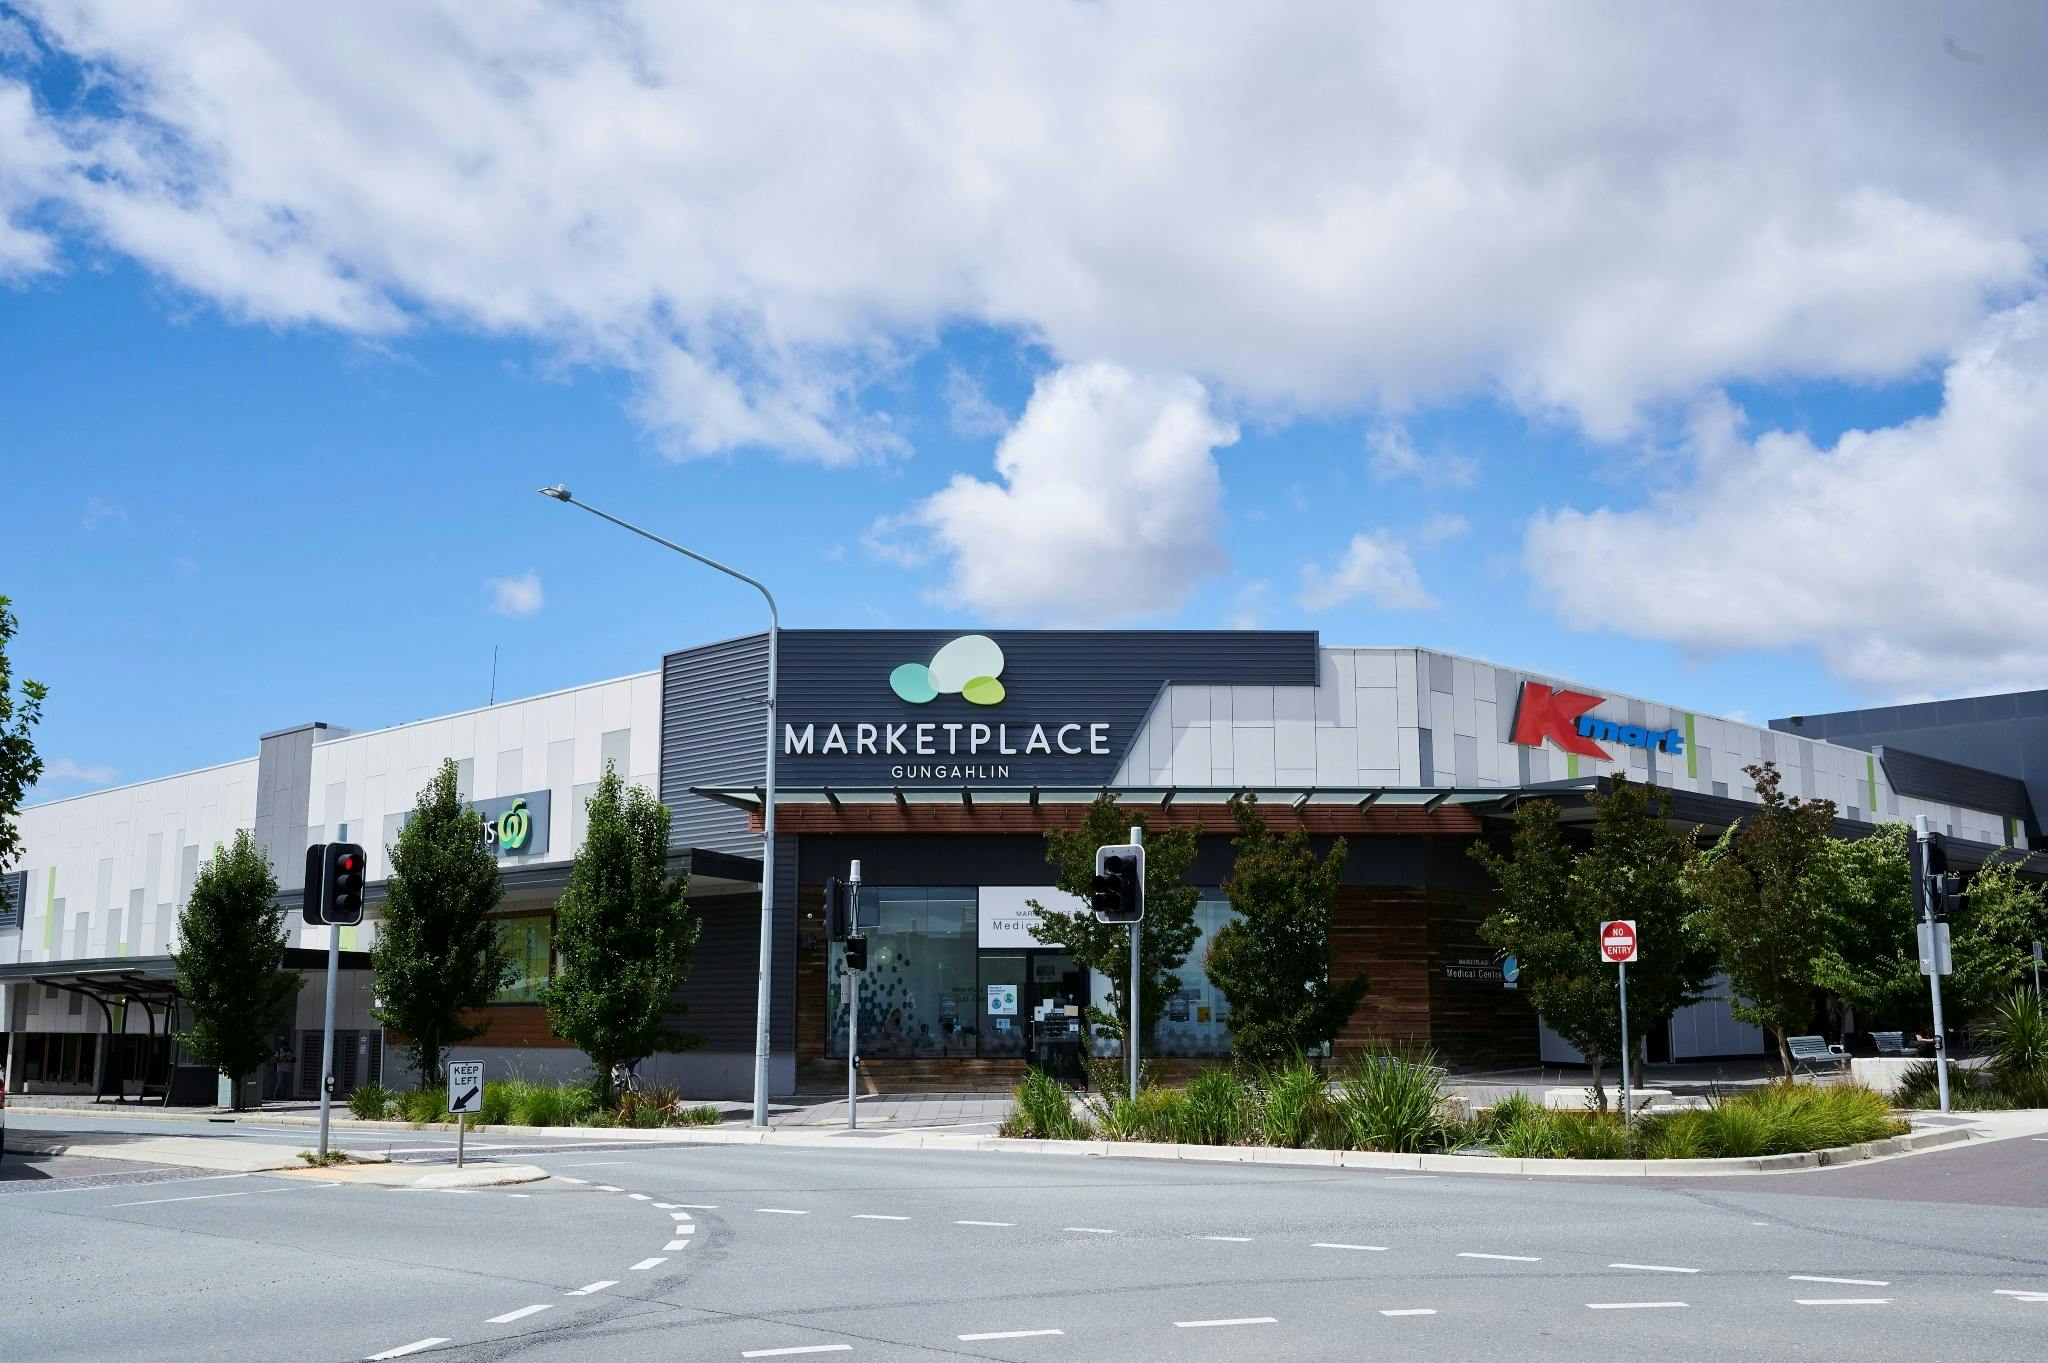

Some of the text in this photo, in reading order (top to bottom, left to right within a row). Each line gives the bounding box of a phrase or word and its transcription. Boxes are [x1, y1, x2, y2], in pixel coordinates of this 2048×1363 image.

[1509, 680, 1685, 762] Kmart
[784, 723, 1111, 756] MARKETPLACE
[891, 764, 1010, 779] GUNGAHLIN
[1612, 928, 1624, 937] NO
[1607, 946, 1632, 955] ENTRY
[1446, 967, 1502, 979] Medical Centre
[454, 1066, 479, 1075] KEEP
[454, 1076, 478, 1086] LEFT
